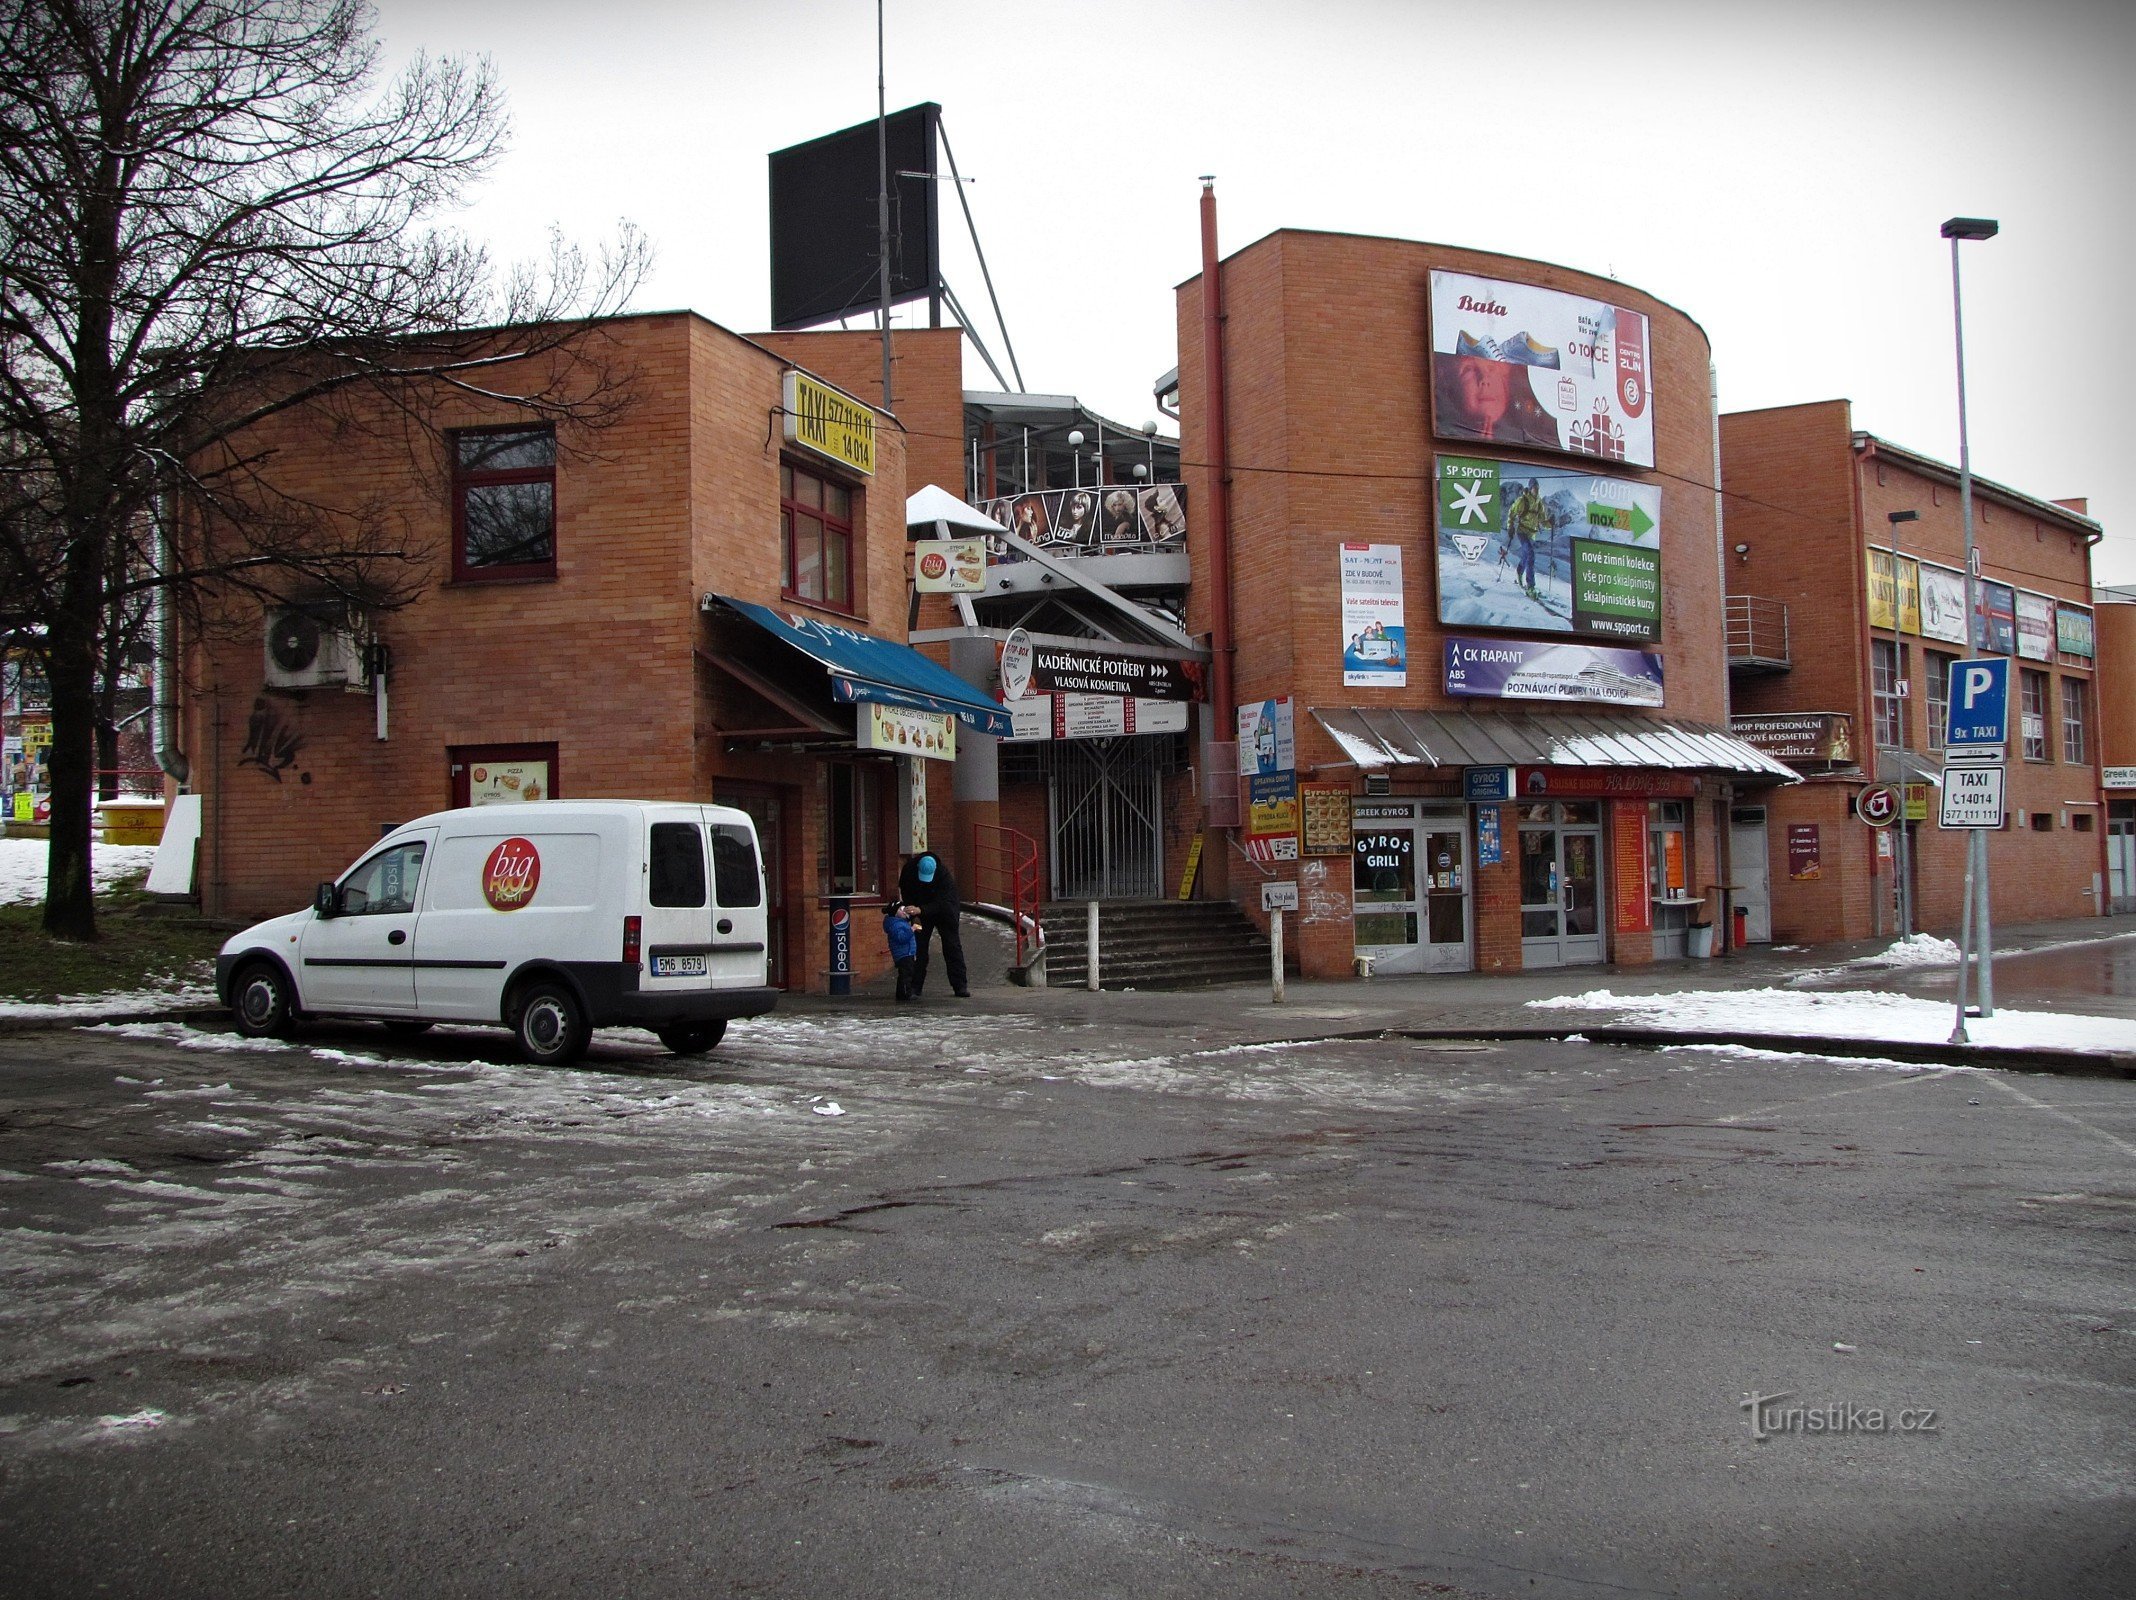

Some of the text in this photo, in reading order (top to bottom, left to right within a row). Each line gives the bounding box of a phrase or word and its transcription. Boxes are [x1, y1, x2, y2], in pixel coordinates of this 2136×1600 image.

[1457, 295, 1508, 317] Bata
[799, 382, 827, 446] TAXI
[828, 397, 844, 427] 577
[853, 440, 869, 467] 014
[1446, 465, 1494, 479] SP SPORT
[1589, 478, 1631, 501] 400m
[1582, 550, 1655, 572] nové zimní kolekce
[1582, 570, 1656, 593] vše pro skialpinisty
[1583, 591, 1656, 612] skialpinistické kurzy
[1591, 619, 1650, 636] www.spsport.cz
[1463, 649, 1523, 664] CK RAPANT
[1038, 652, 1146, 678] KADEŘNICKÉ POTŘEBY
[1449, 670, 1466, 680] ABS
[1054, 675, 1131, 693] VLASOVÁ KOSMETIKA
[1507, 682, 1558, 695] POZNÁVACÍ
[1590, 685, 1601, 697] NA
[1964, 667, 1993, 710] P
[1754, 719, 1822, 731] PROFESIONÁLNÍ
[1954, 726, 1997, 739] 9x TAXI
[1768, 732, 1816, 741] KOSMETIKY
[1472, 772, 1501, 784] GYROS
[1959, 773, 1988, 787] TAXI
[2103, 770, 2128, 779] Greek
[1304, 789, 1331, 797] Gyros
[1471, 788, 1501, 796] ORIGINAL
[1960, 793, 1992, 805] 14014
[1355, 808, 1409, 816] GREEK GYROS
[1945, 809, 1998, 819] 577 111 111
[1357, 835, 1410, 853] GYROS
[493, 844, 535, 898] big
[835, 931, 848, 972] pepsi
[659, 957, 702, 971] 5M6 8579
